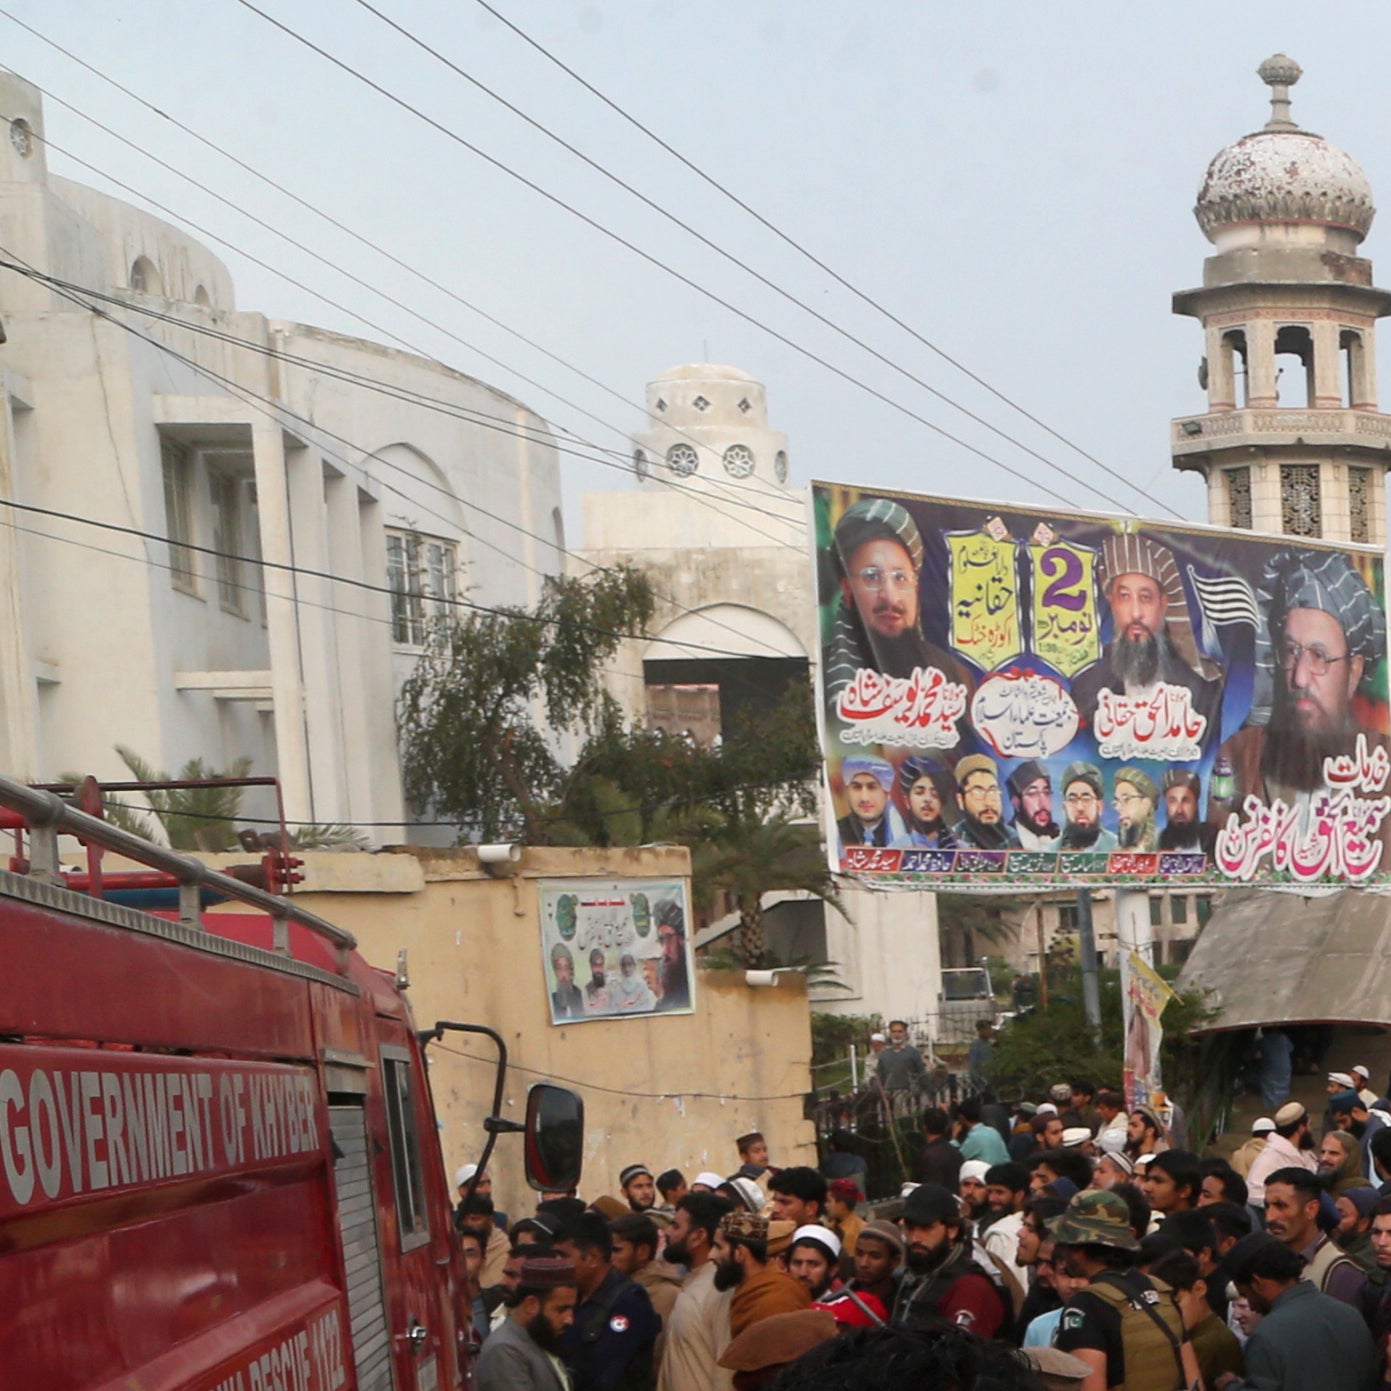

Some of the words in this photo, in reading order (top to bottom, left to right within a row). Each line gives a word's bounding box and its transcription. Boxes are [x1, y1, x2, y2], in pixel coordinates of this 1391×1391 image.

[1040, 548, 1087, 612] 2
[1037, 612, 1092, 645] نومبر
[1099, 695, 1135, 737] حقانی
[0, 1069, 213, 1205] GOVERNMENT
[223, 1072, 248, 1163] OF
[250, 1074, 320, 1159] KHYBER
